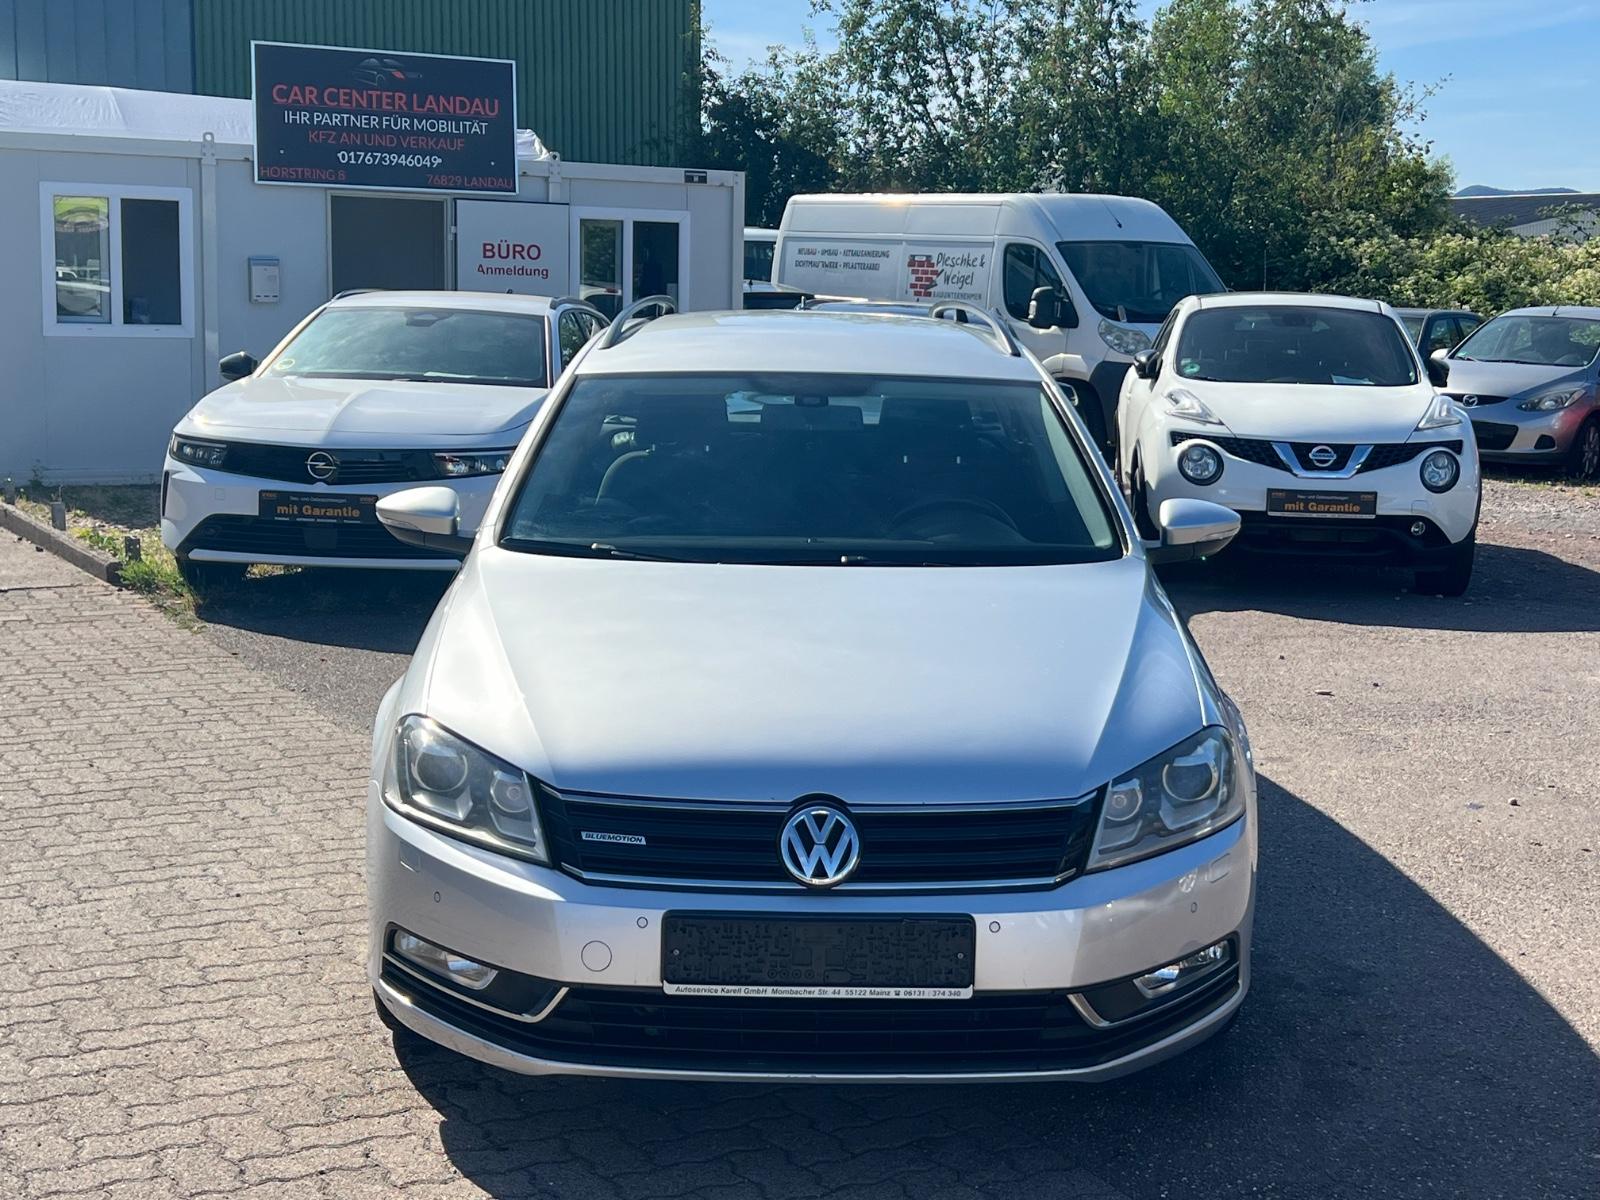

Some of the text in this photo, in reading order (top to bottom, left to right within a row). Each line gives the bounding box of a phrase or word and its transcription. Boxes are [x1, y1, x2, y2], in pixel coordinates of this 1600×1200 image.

[272, 84, 499, 116] CAR CENTER LANDAU
[284, 110, 488, 135] IHR PARTNER FÜR MOBILITÄT
[308, 130, 465, 151] KFZ AN UND VERKAUF
[339, 150, 439, 168] 017673946049
[260, 166, 346, 181] HORSTRING 8
[426, 173, 513, 189] 76829 LANDAU
[482, 239, 542, 261] BÜRO
[936, 252, 978, 268] Pleschke
[477, 263, 549, 280] Anmeldung
[943, 270, 974, 290] Weigel
[276, 504, 360, 517] mit Garantie
[1284, 501, 1360, 513] mit Garantie
[584, 832, 643, 844] BLUEMOTION
[675, 986, 718, 995] Autoservice
[743, 987, 767, 995] GmbH
[771, 987, 815, 996] Mombacher
